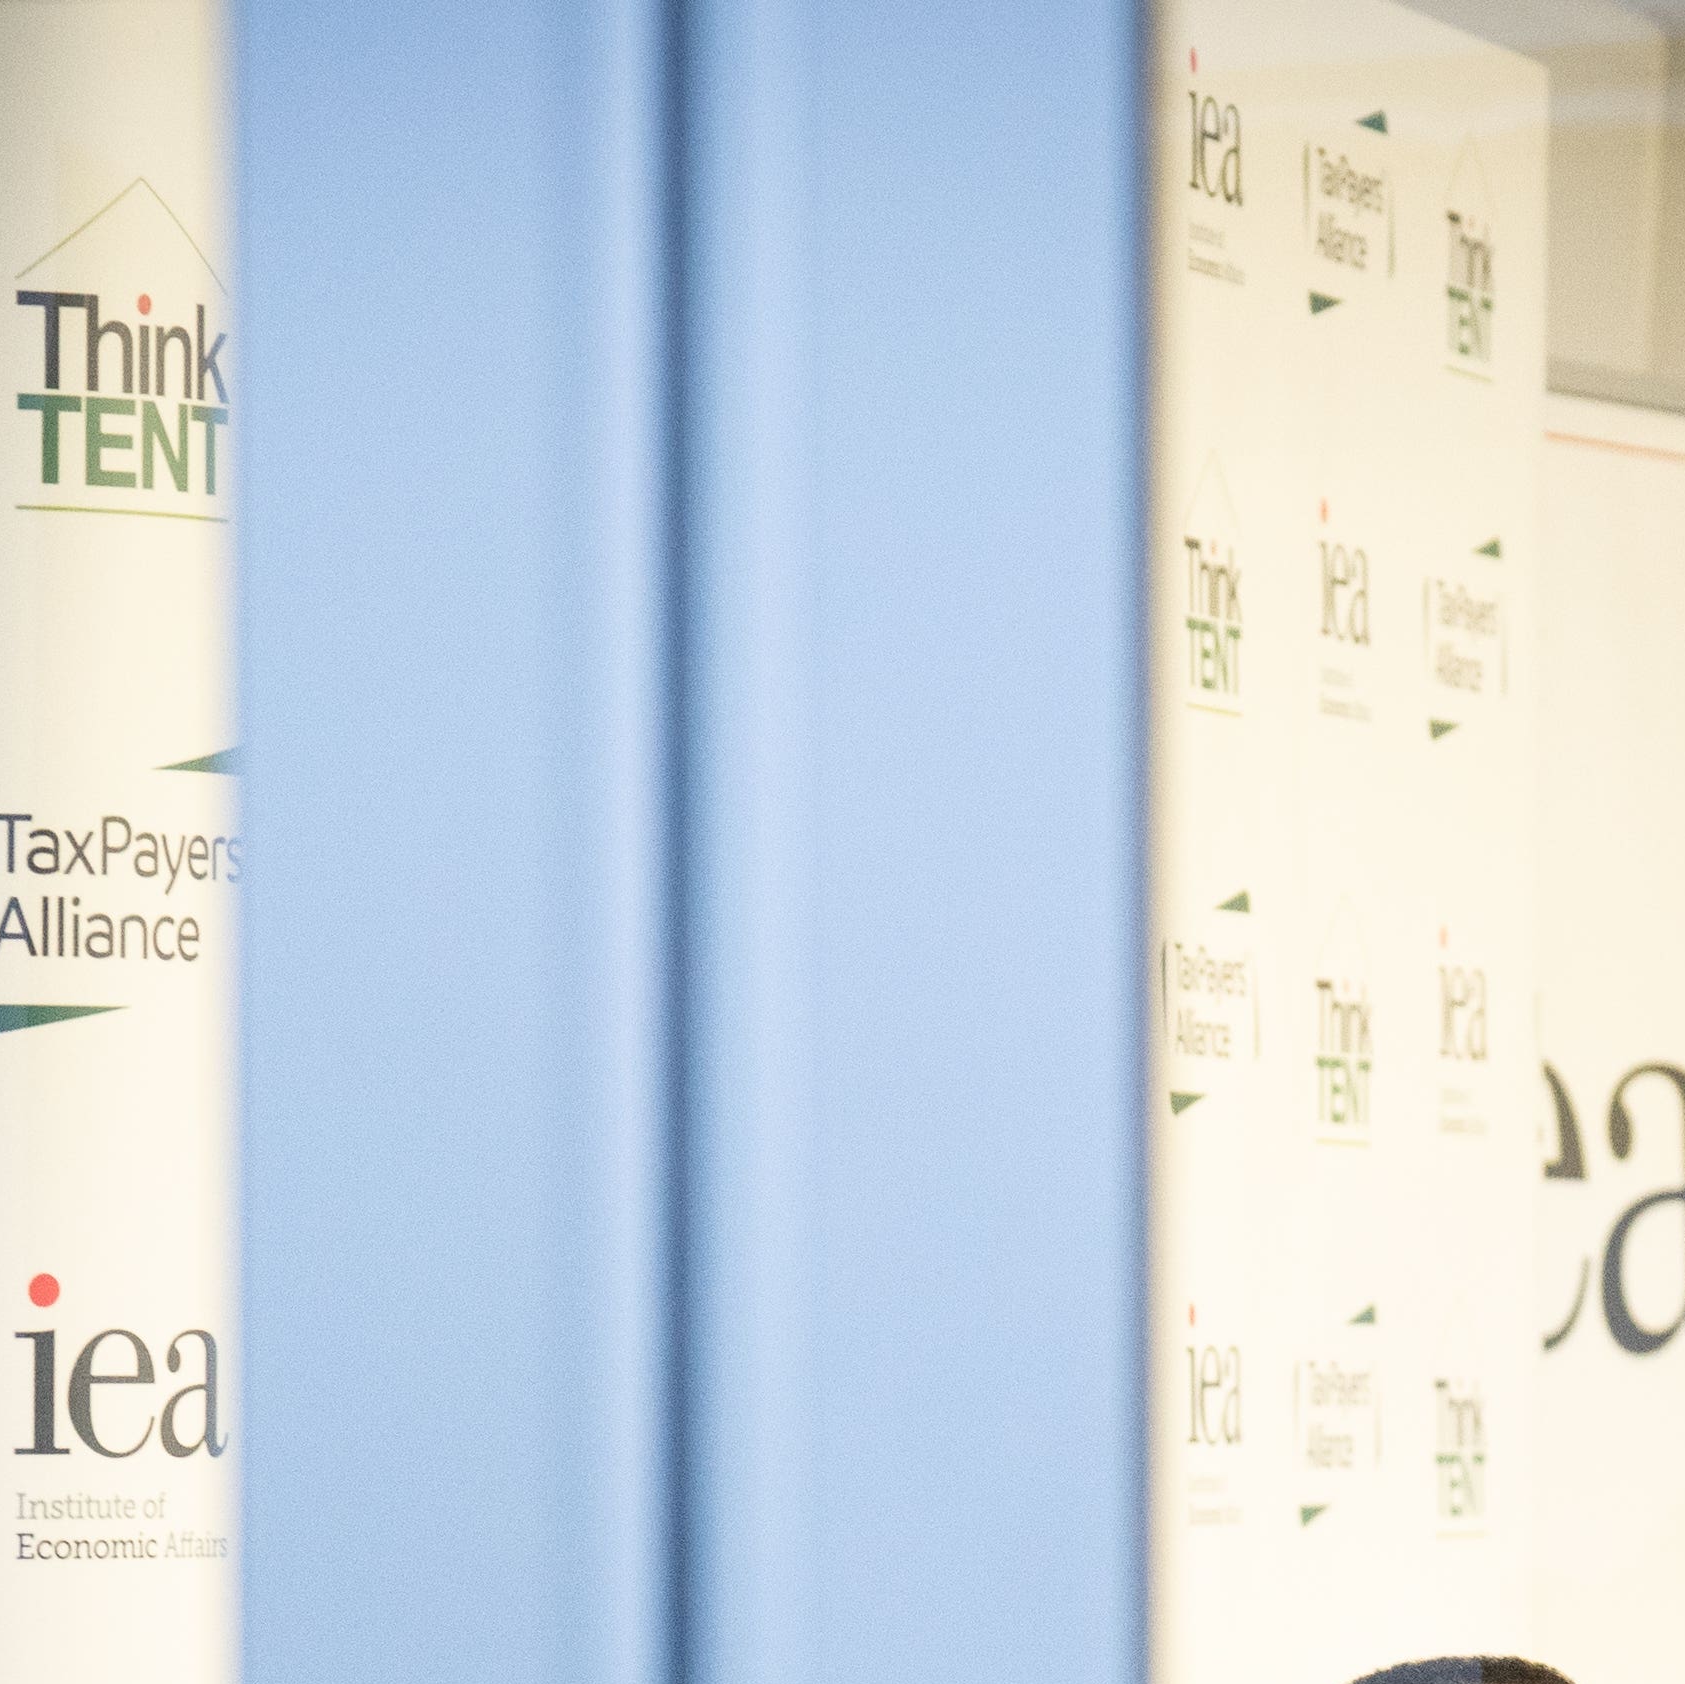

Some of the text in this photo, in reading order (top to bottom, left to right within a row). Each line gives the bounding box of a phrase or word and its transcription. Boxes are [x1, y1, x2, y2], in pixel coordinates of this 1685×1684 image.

[15, 289, 229, 404] Think
[16, 393, 229, 496] TENT
[1184, 534, 1241, 624] Think
[1185, 616, 1241, 694] TENT
[13, 1272, 229, 1459] iea
[16, 1491, 167, 1521] Institute of
[16, 1530, 228, 1560] Economic Affairs
